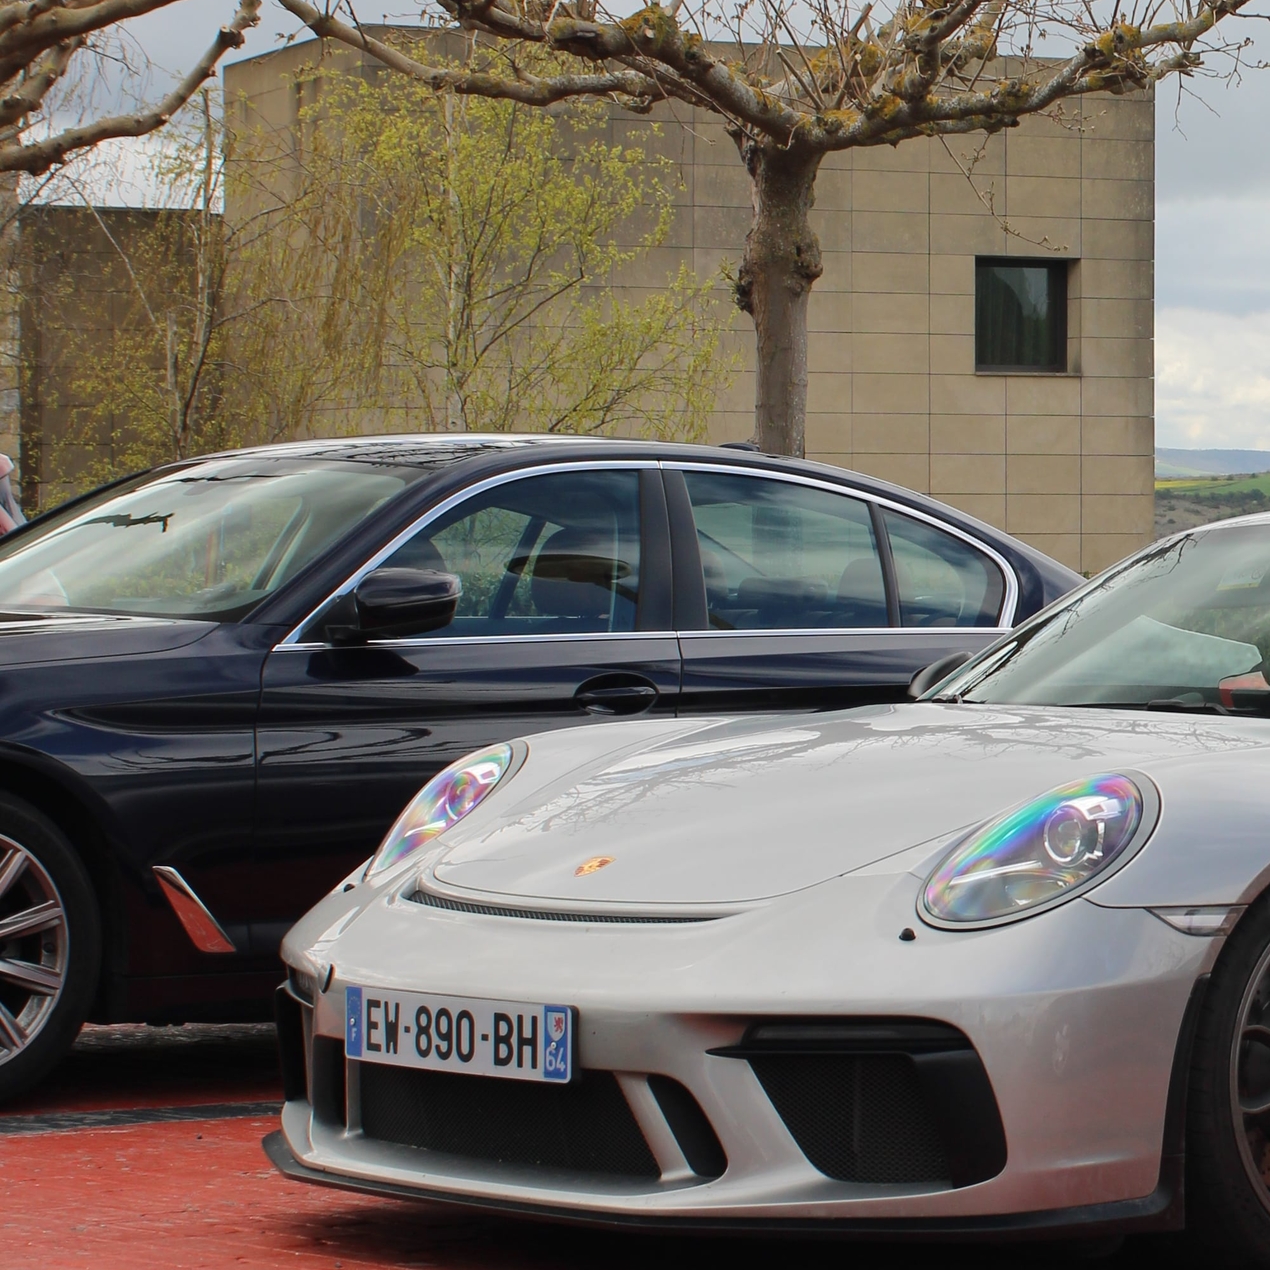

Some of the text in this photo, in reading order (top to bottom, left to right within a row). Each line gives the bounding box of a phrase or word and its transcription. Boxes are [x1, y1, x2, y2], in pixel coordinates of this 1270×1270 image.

[351, 1027, 358, 1042] F
[366, 998, 538, 1070] EW-890-BH
[545, 1046, 566, 1072] 64
